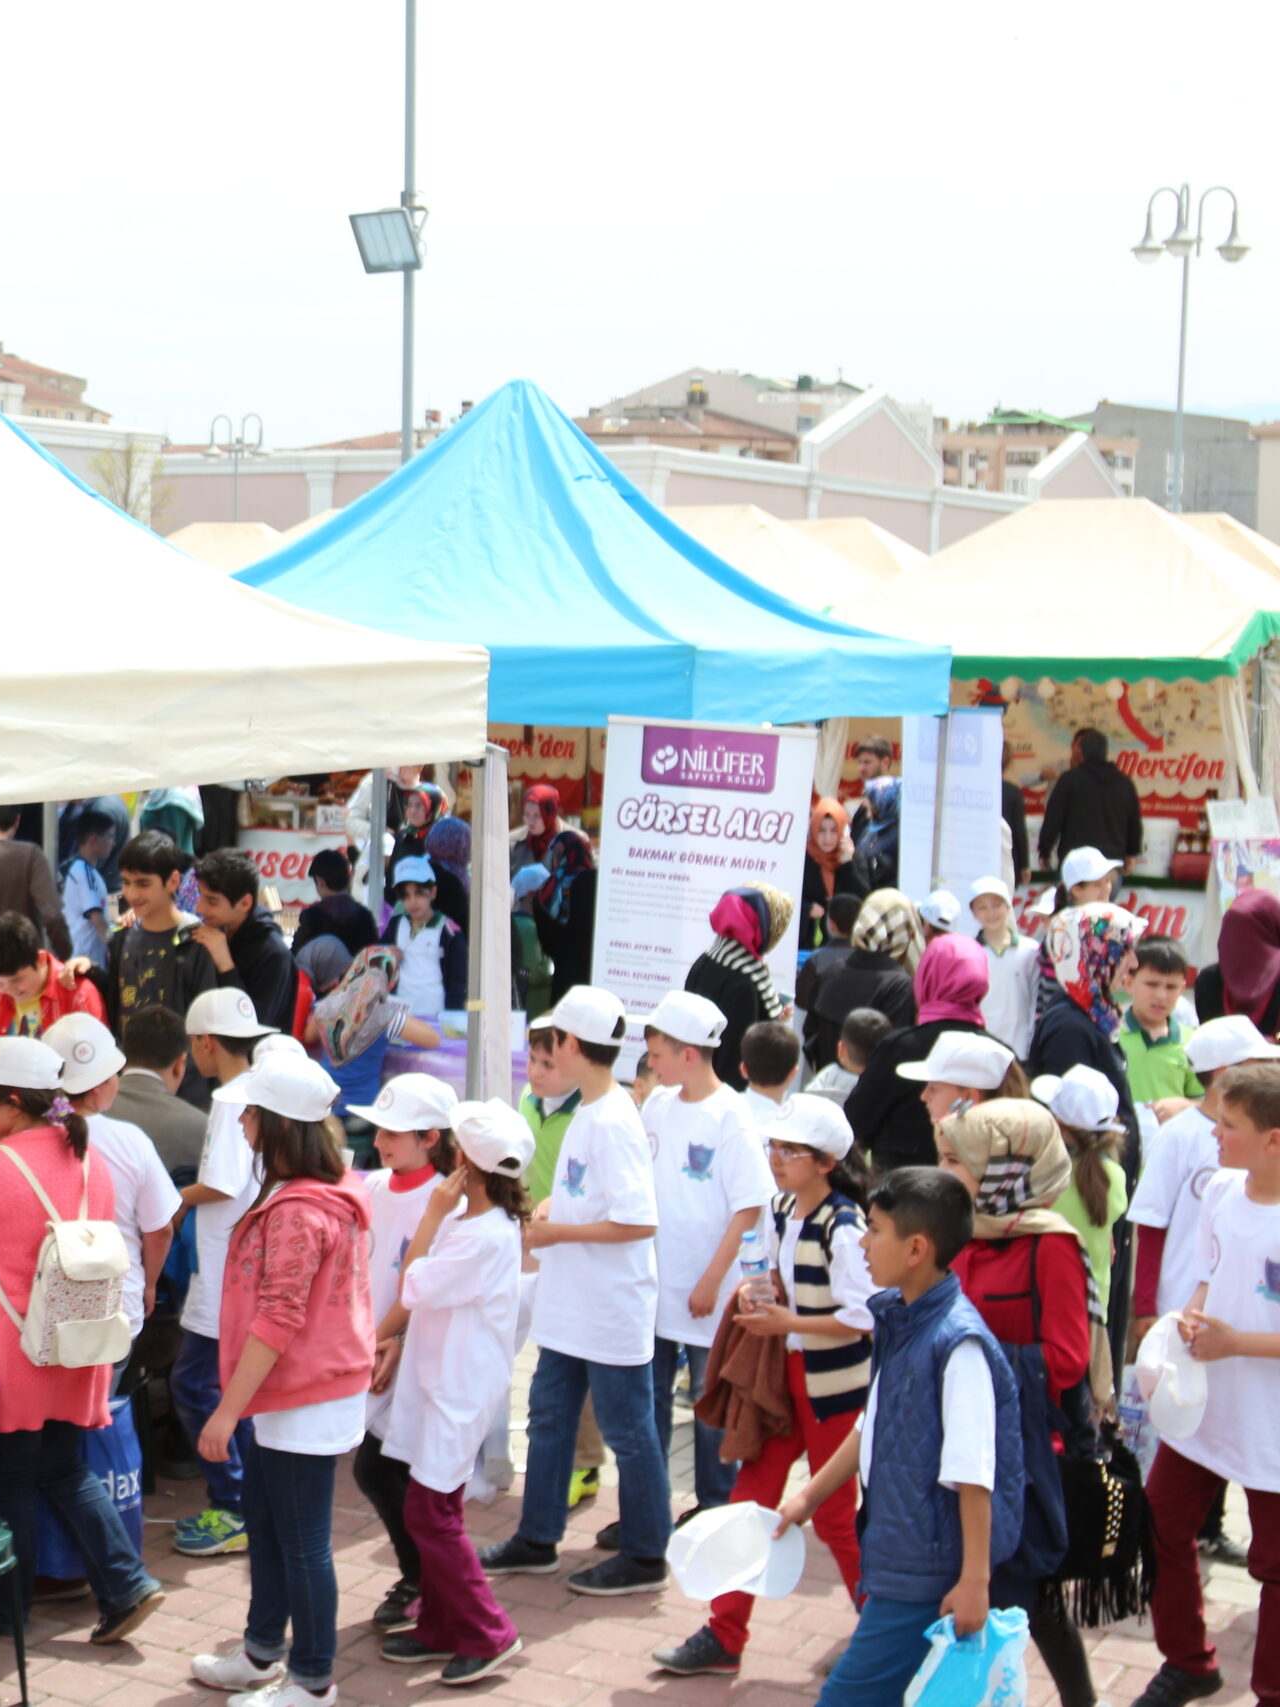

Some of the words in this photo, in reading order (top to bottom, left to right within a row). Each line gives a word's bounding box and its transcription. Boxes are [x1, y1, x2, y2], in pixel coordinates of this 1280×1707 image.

[681, 744, 765, 776] NİLÜFER
[1115, 750, 1226, 785] Merzifon
[681, 771, 721, 782] SAFVET
[728, 774, 766, 787] KOLEJİ
[617, 793, 721, 836] GÖRSEL
[724, 807, 794, 844] ALGI
[629, 847, 677, 864] BAKMAK
[679, 851, 728, 868] GÖRMEK
[730, 855, 767, 873] MİDİR
